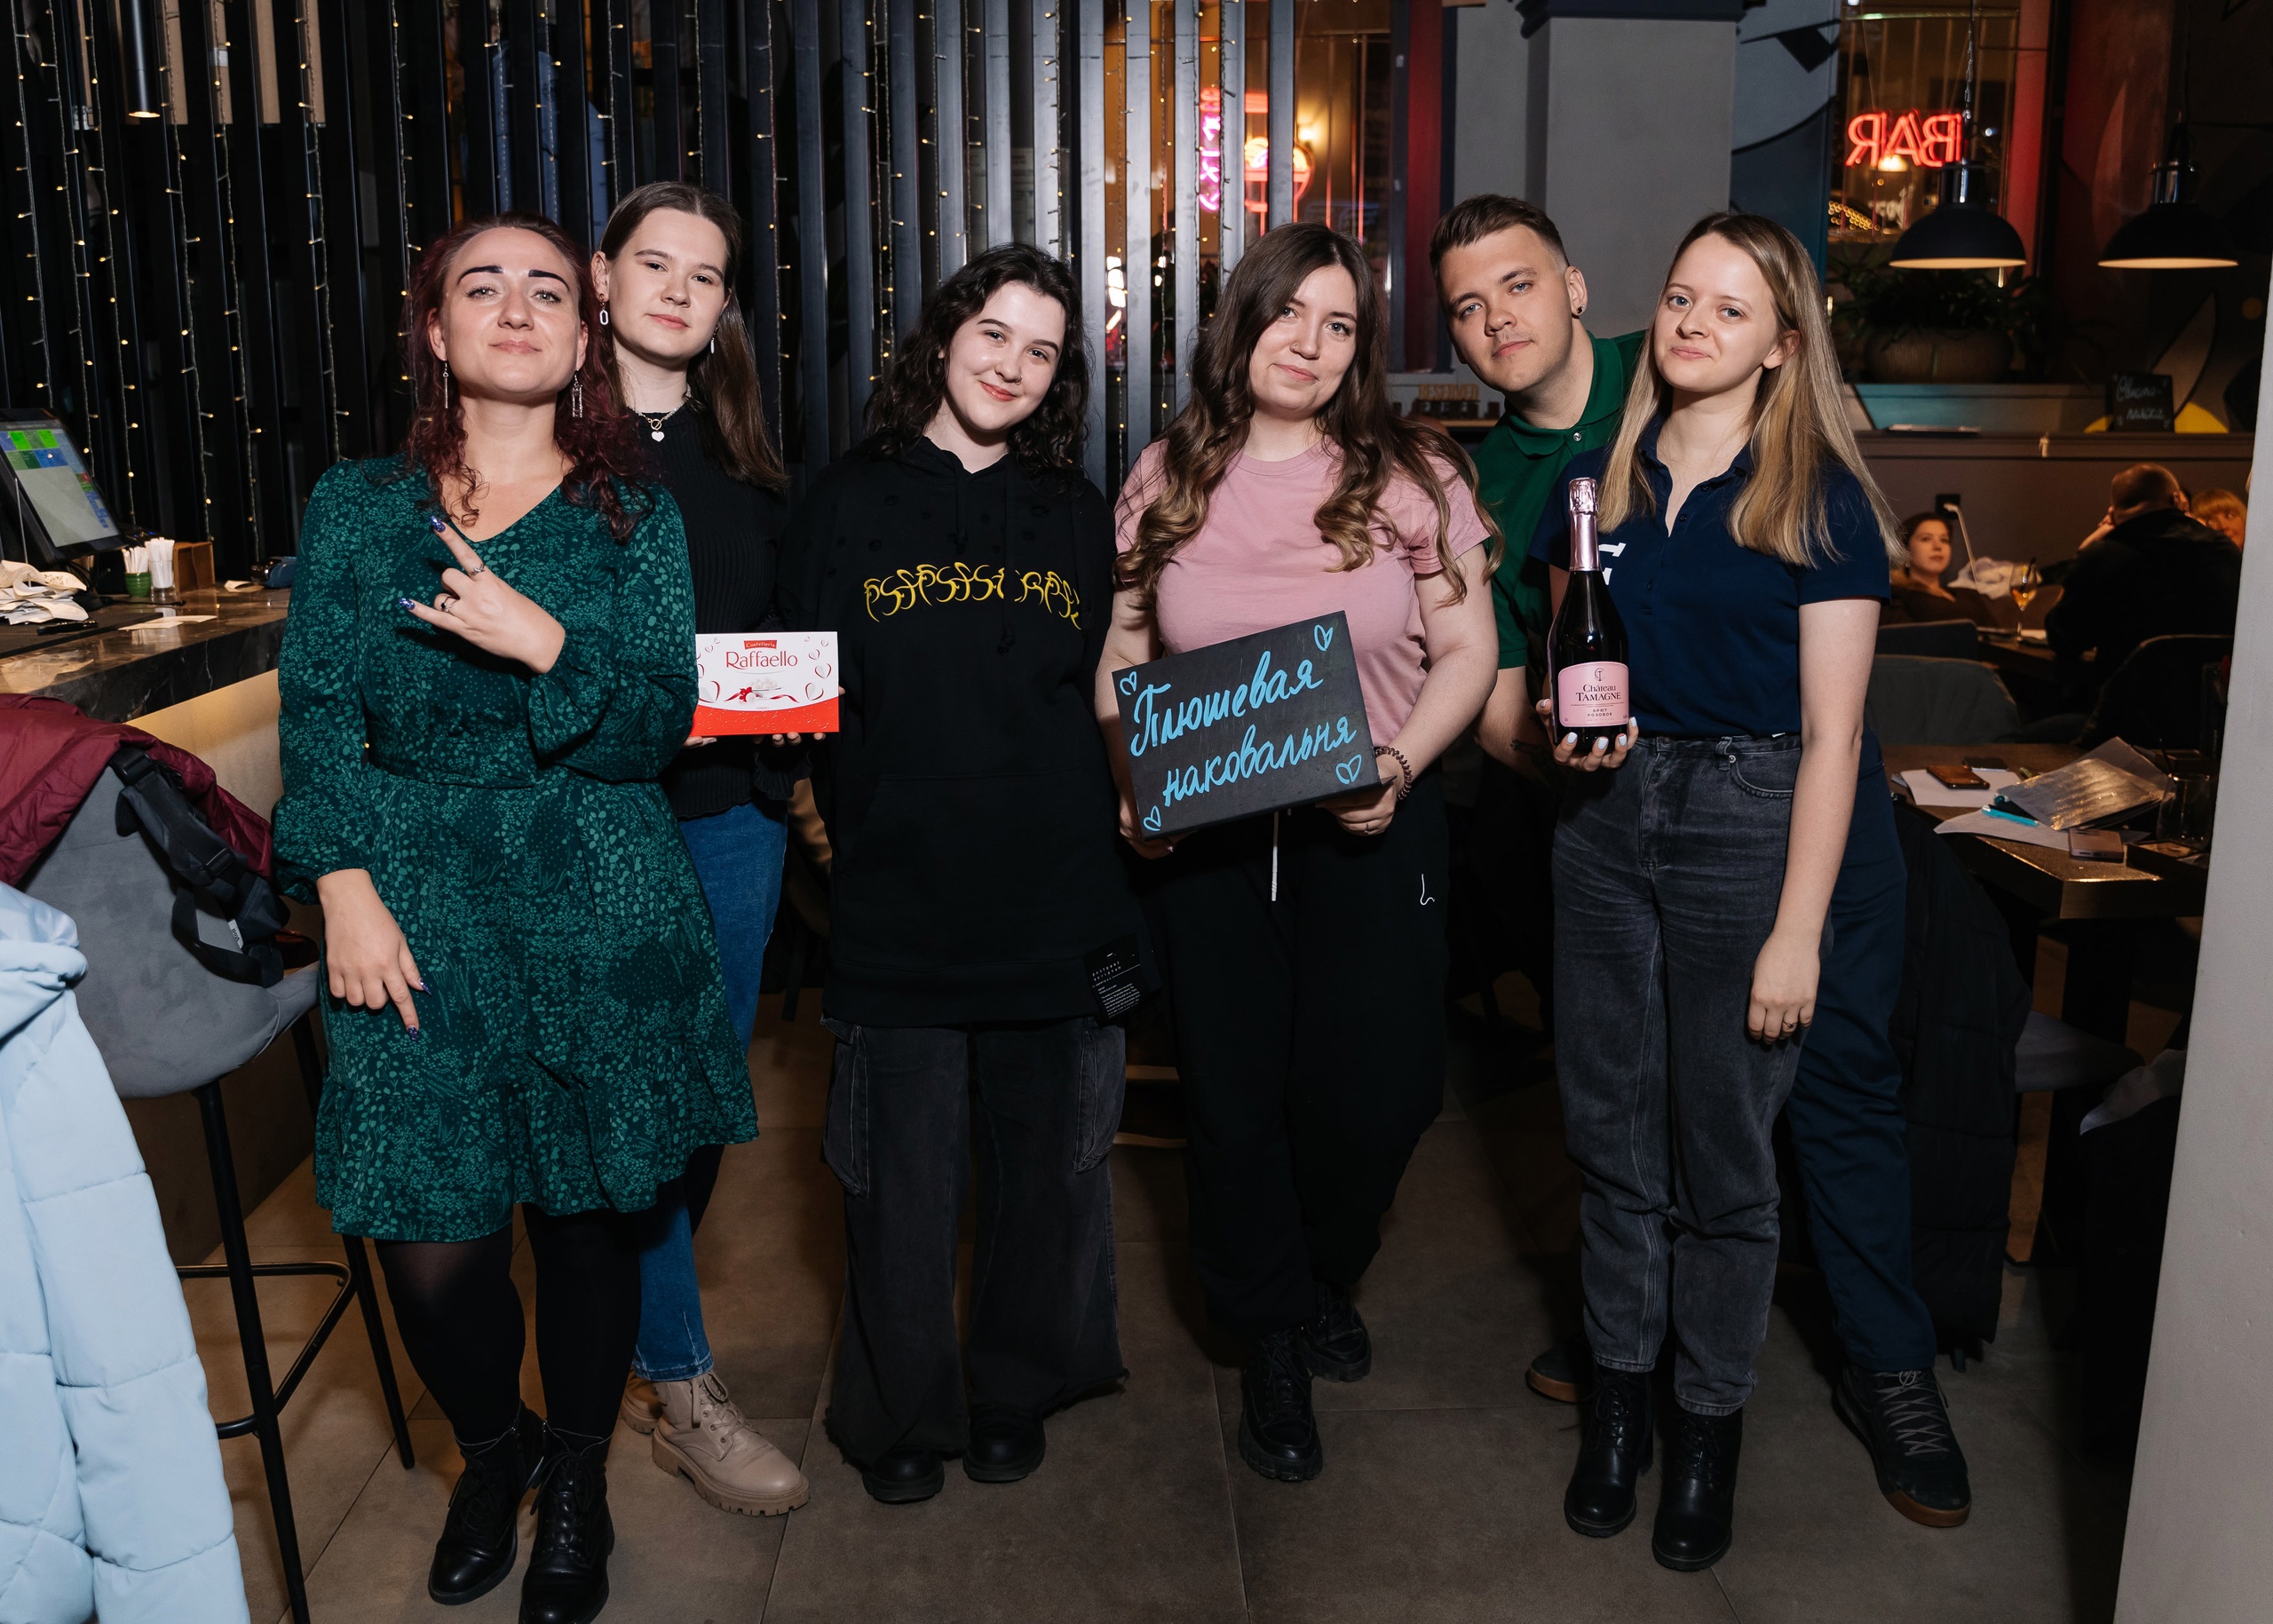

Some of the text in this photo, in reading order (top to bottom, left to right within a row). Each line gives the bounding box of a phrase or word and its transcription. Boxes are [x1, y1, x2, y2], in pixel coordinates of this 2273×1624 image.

[725, 650, 798, 670] Raffaello
[1575, 692, 1621, 701] TAMAGNE
[1582, 684, 1616, 693] Château
[1129, 650, 1324, 757] Плюшевая
[1161, 716, 1358, 807] наковальня
